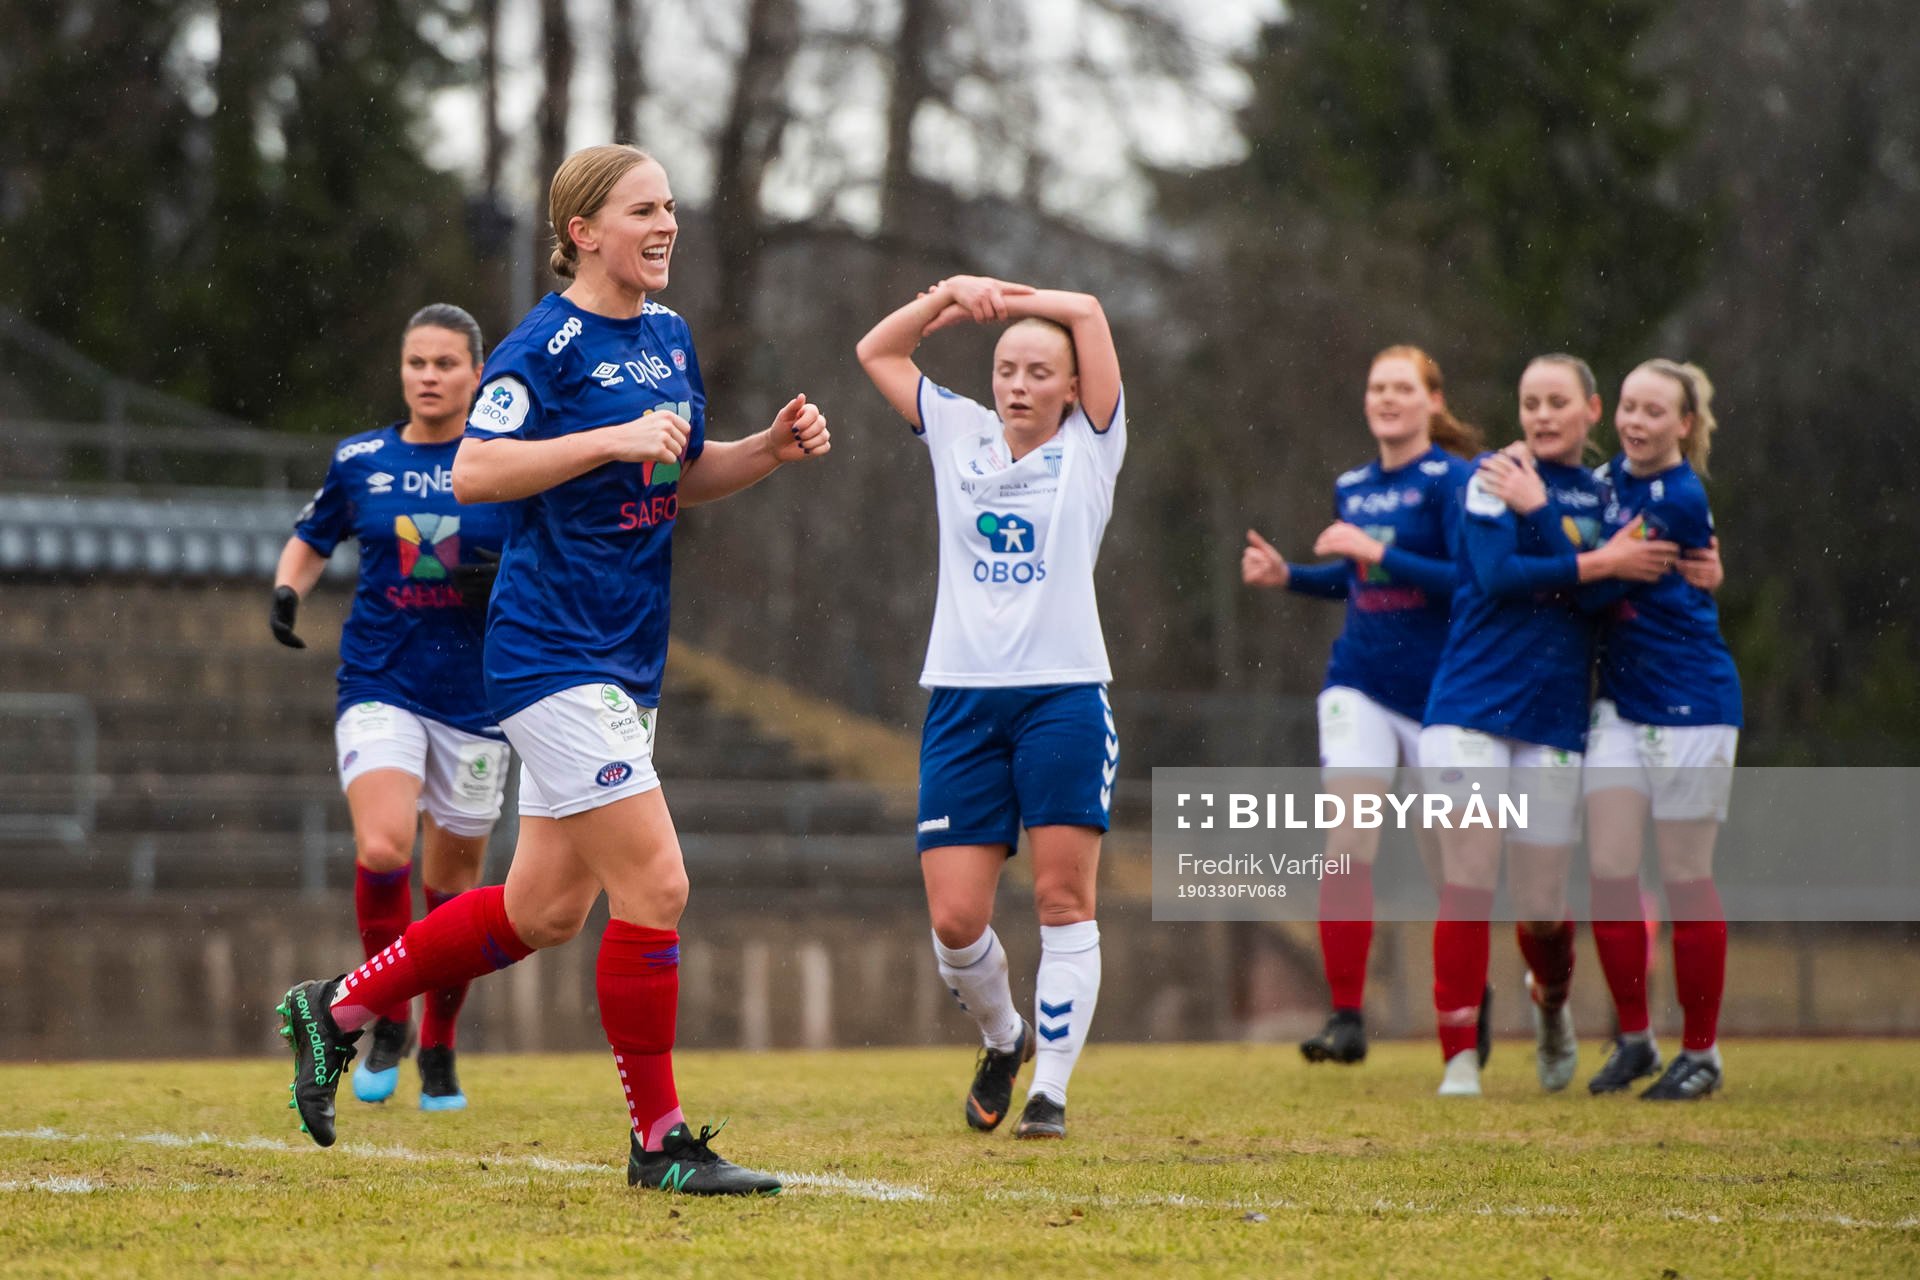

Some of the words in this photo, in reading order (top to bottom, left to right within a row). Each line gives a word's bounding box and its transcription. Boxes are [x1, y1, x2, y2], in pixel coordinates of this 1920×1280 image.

[547, 317, 582, 355] coop
[600, 375, 624, 388] umbro
[625, 349, 671, 389] DNB
[973, 560, 1046, 584] OBOS
[295, 989, 312, 1020] new
[305, 1021, 327, 1086] balance
